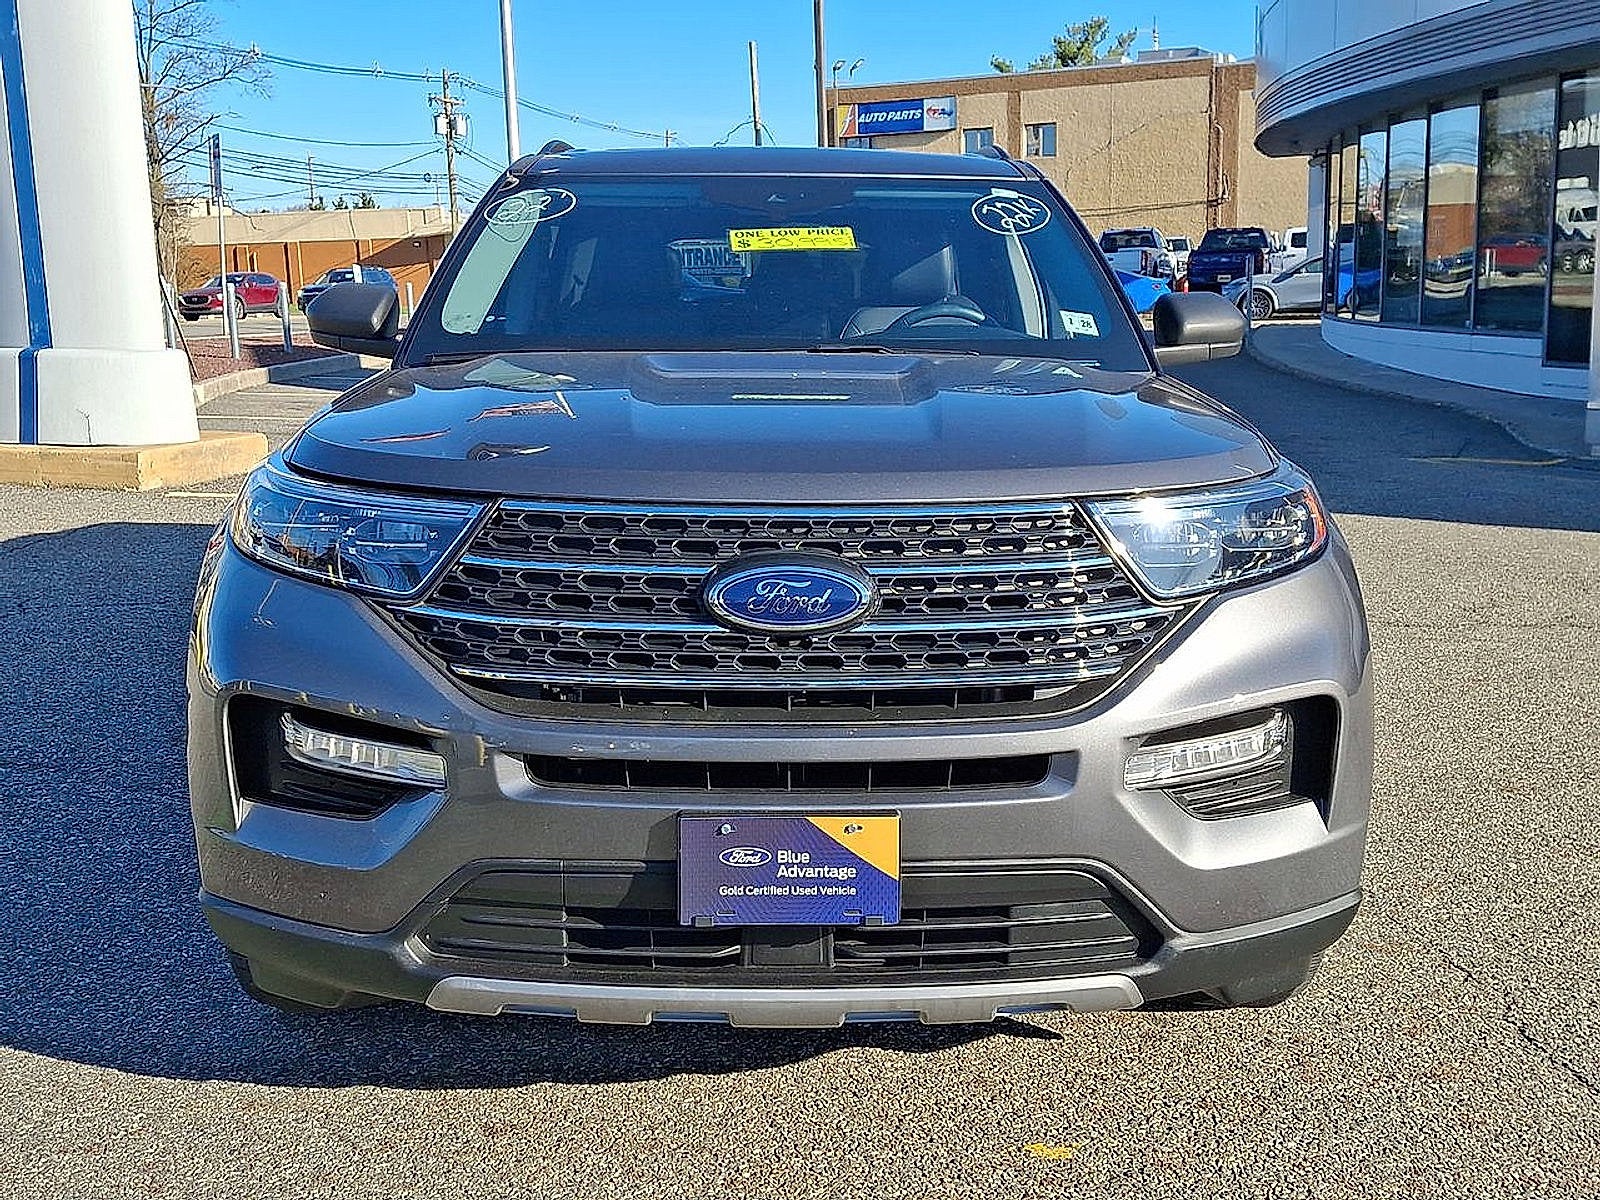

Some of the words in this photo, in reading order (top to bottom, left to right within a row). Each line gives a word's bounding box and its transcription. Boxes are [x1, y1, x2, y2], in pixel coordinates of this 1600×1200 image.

[859, 111, 886, 123] AUTO
[887, 109, 922, 122] PARTS
[770, 230, 800, 238] LOW
[748, 579, 831, 614] Ford
[729, 849, 762, 864] Ford
[777, 850, 810, 864] Blue
[777, 865, 857, 880] Advantage
[719, 886, 744, 896] Gold
[745, 886, 789, 896] Certified
[791, 886, 818, 896] Used
[819, 886, 857, 896] Vehicle
